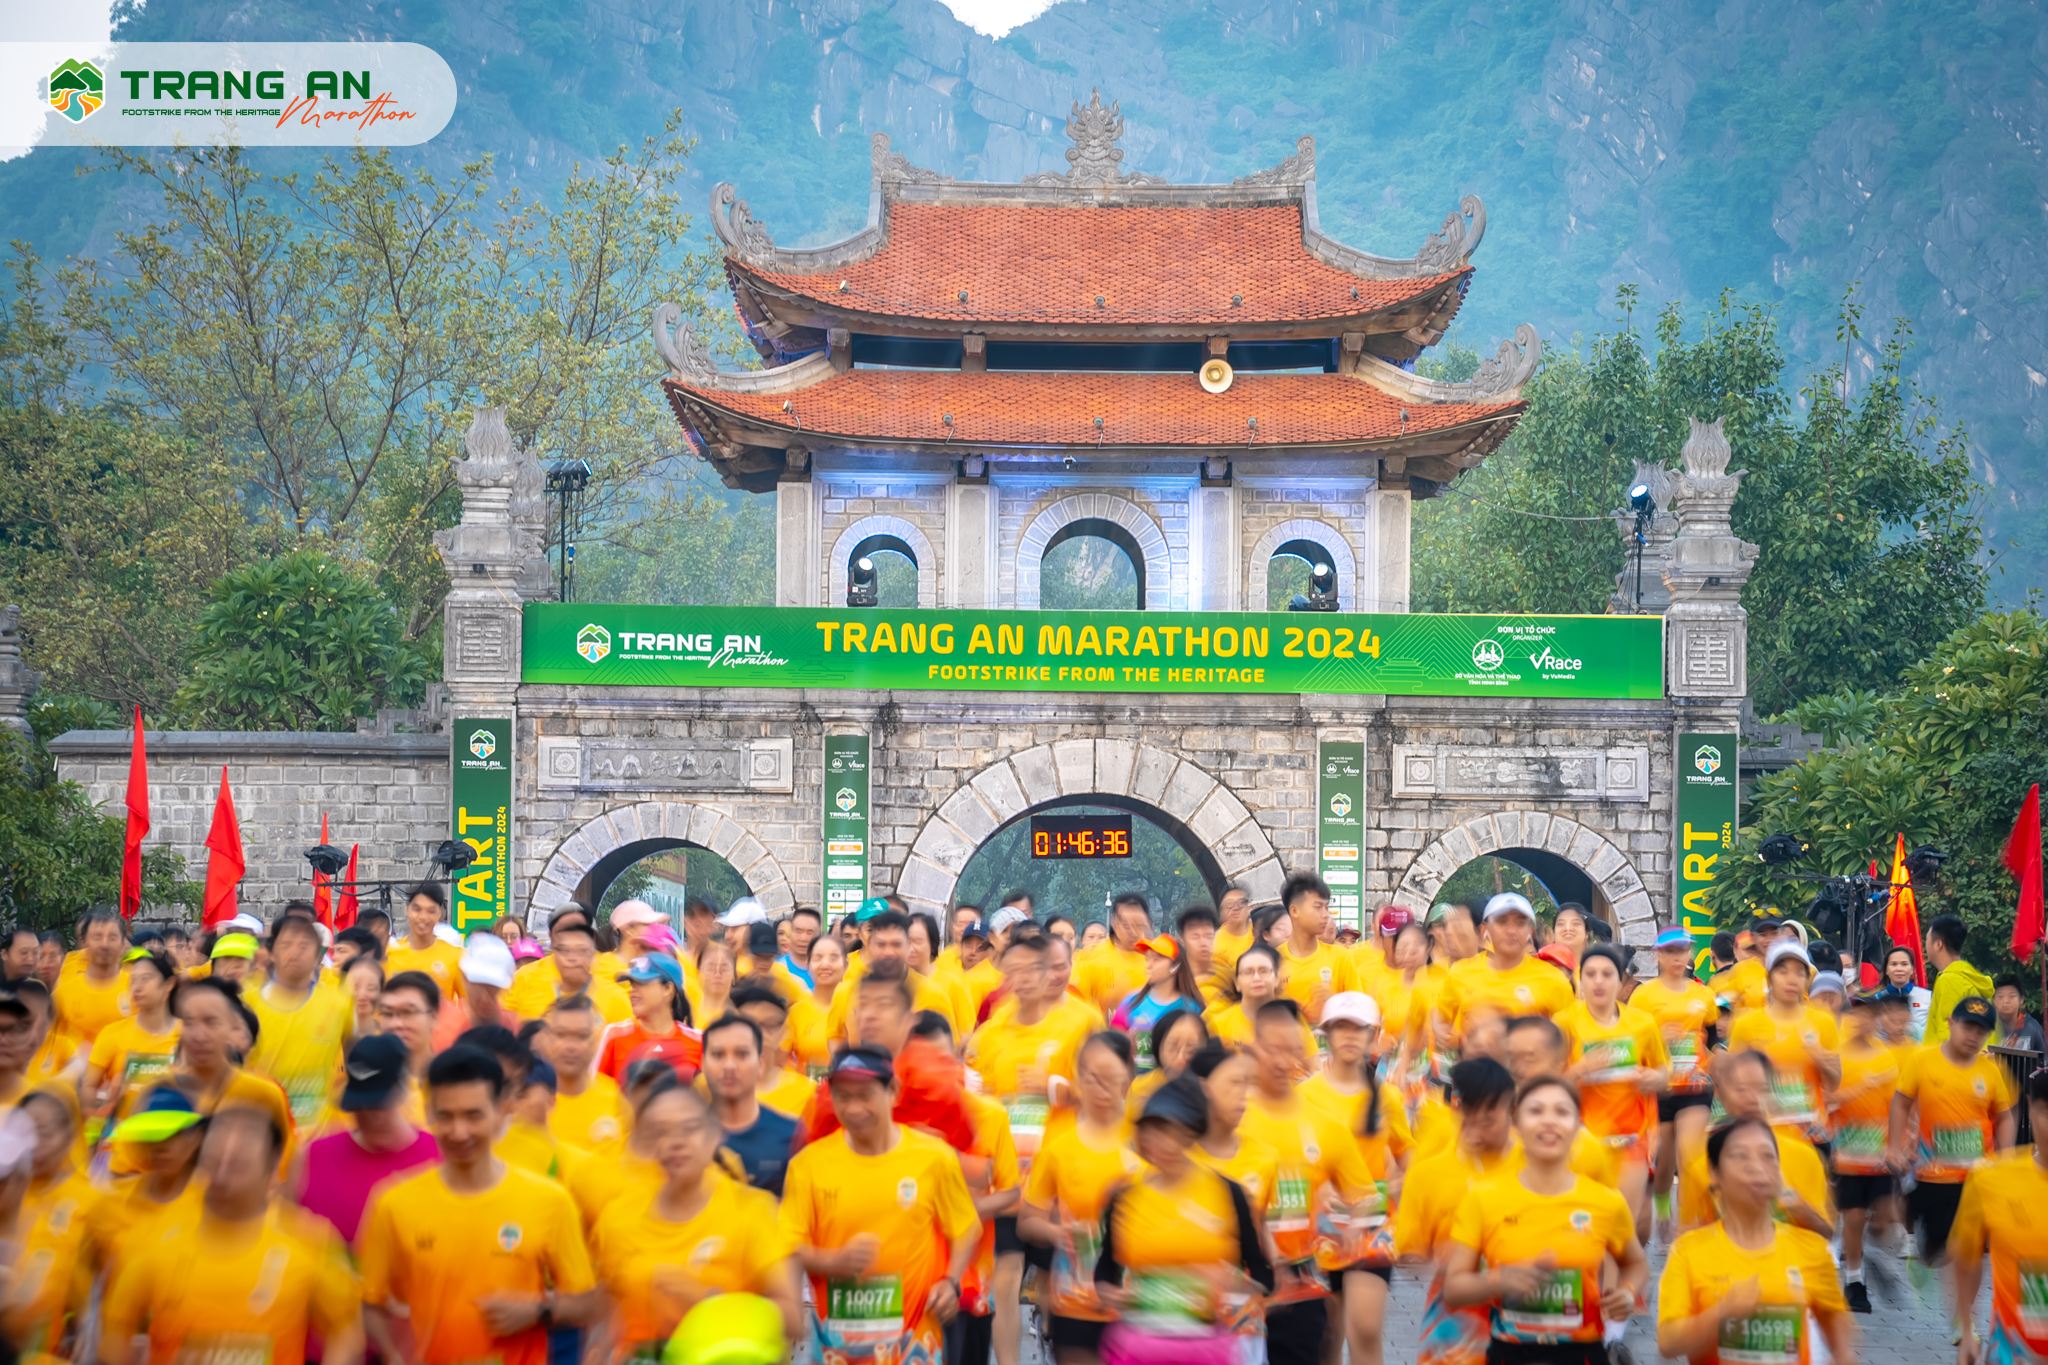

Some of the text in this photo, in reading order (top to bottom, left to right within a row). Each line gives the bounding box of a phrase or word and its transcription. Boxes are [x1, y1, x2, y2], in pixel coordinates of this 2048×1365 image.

[618, 632, 761, 653] TRANG AN
[816, 621, 1381, 660] TRANG AN MARATHON 2024
[707, 647, 789, 669] Marathon
[927, 664, 1266, 684] FOOTSTRIKE FROM THE HERITAGE
[1034, 829, 1129, 856] 01:46:36
[495, 806, 507, 918] AN MARATHON 2024
[833, 1287, 895, 1307] F 10077
